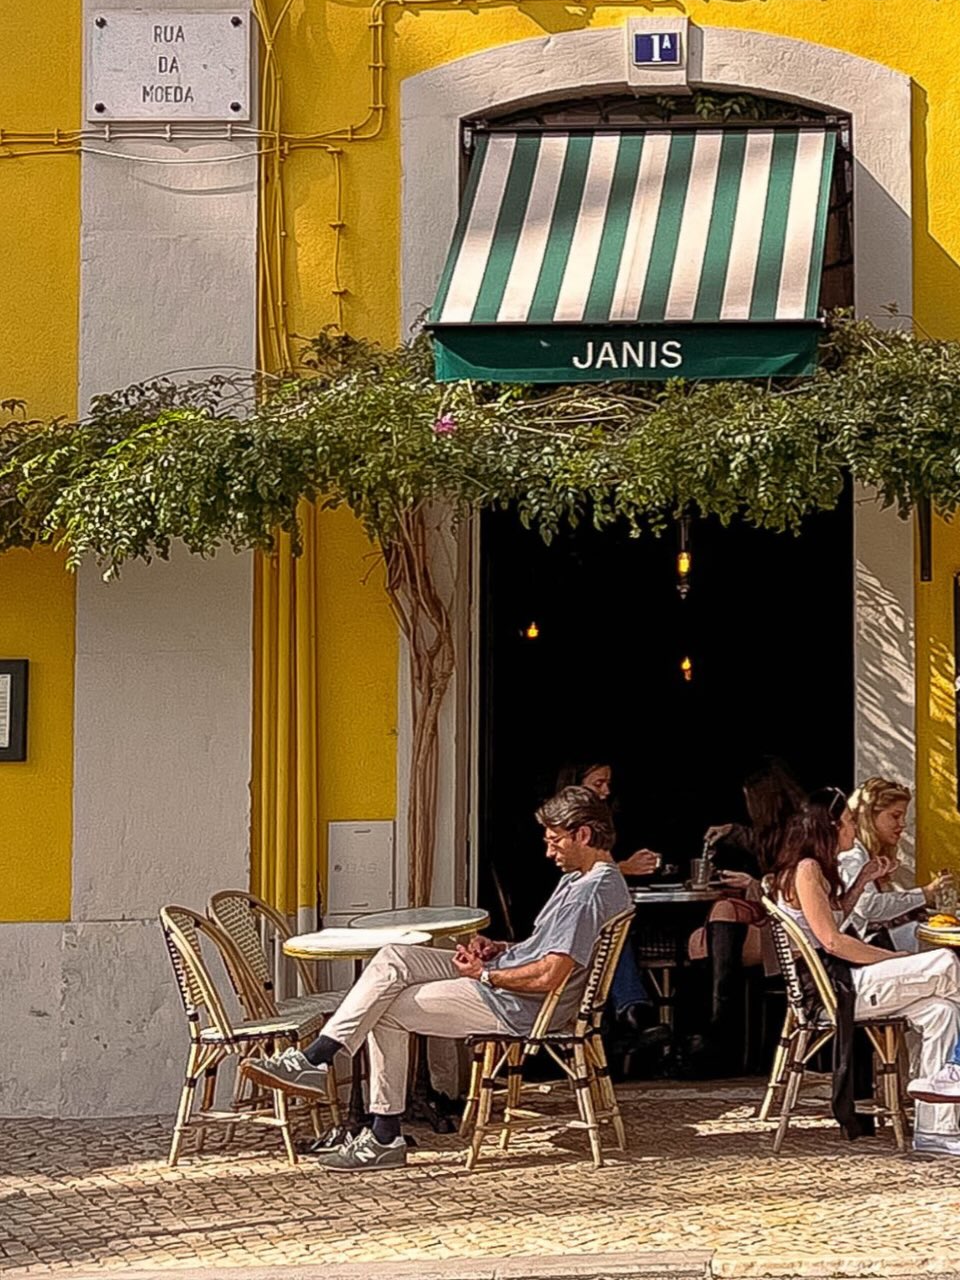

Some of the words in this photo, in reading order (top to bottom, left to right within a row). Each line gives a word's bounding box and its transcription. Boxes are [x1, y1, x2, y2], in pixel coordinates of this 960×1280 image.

[153, 25, 186, 43] RUA
[158, 56, 180, 74] DA
[141, 85, 195, 104] MOEDA
[572, 340, 683, 369] JANIS
